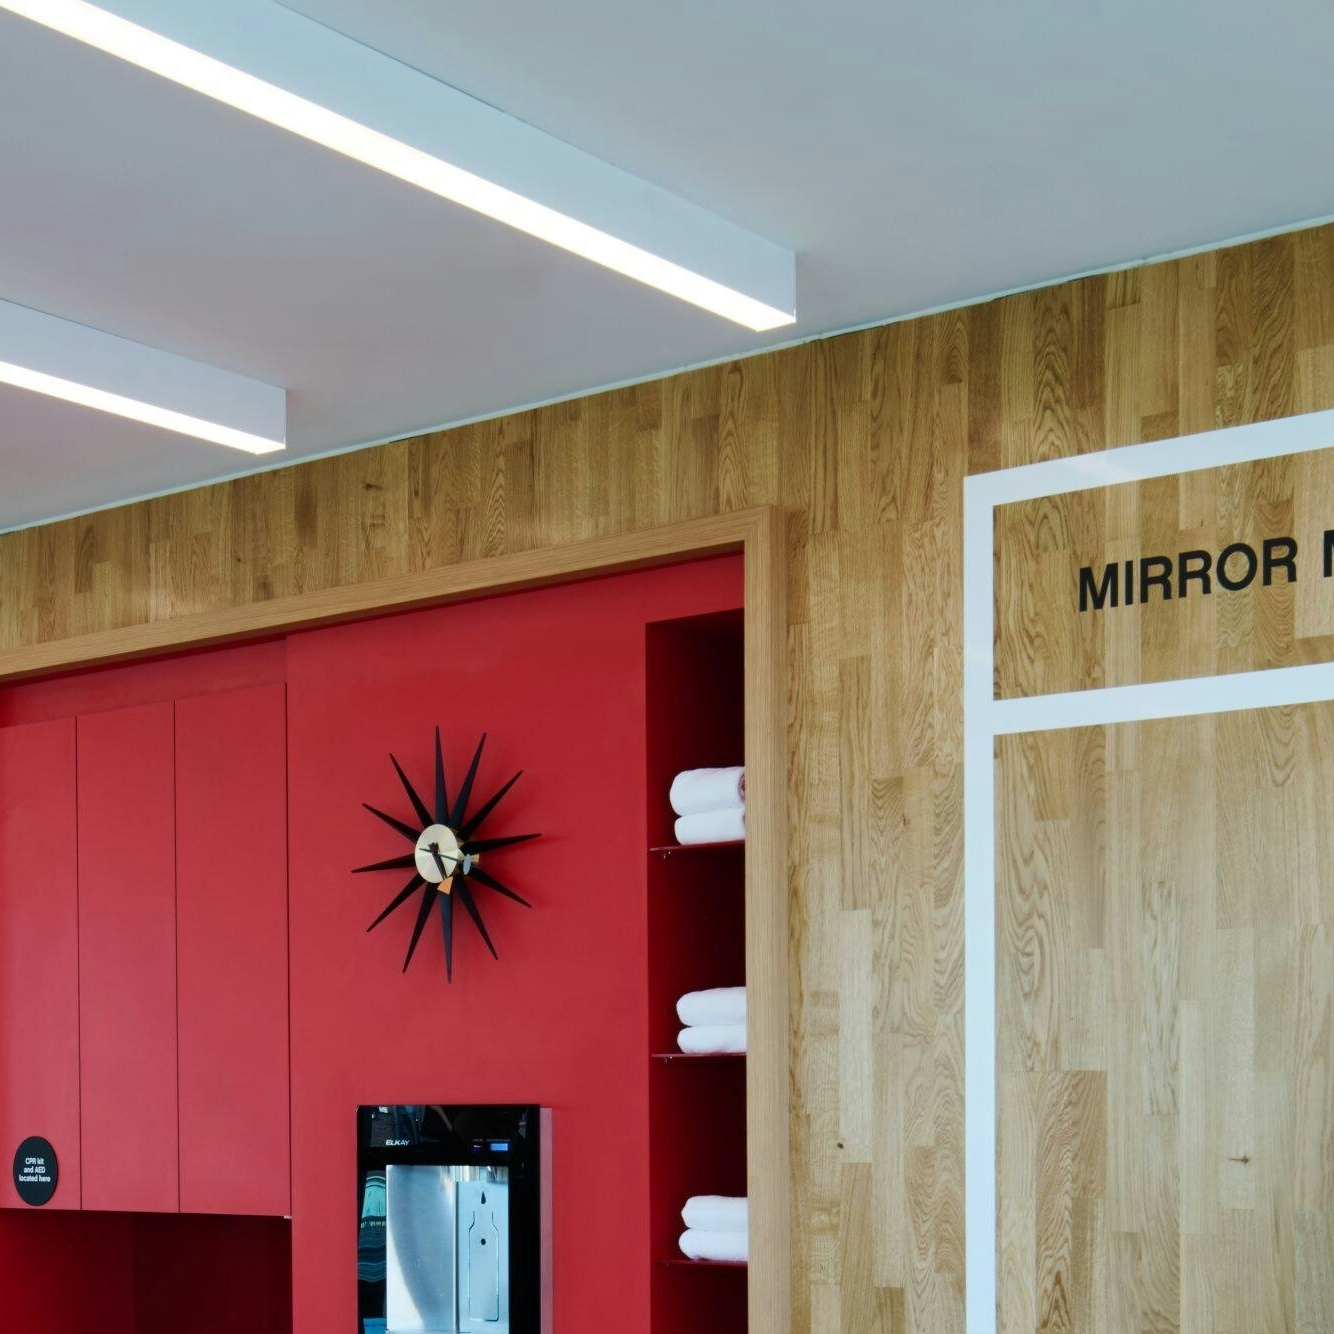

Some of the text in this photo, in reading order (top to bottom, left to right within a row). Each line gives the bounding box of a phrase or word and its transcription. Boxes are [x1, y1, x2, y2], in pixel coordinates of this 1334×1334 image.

[1078, 536, 1298, 613] MIRROR
[25, 1157, 45, 1165] CPR kit
[23, 1166, 46, 1174] and AED
[18, 1174, 39, 1182] located
